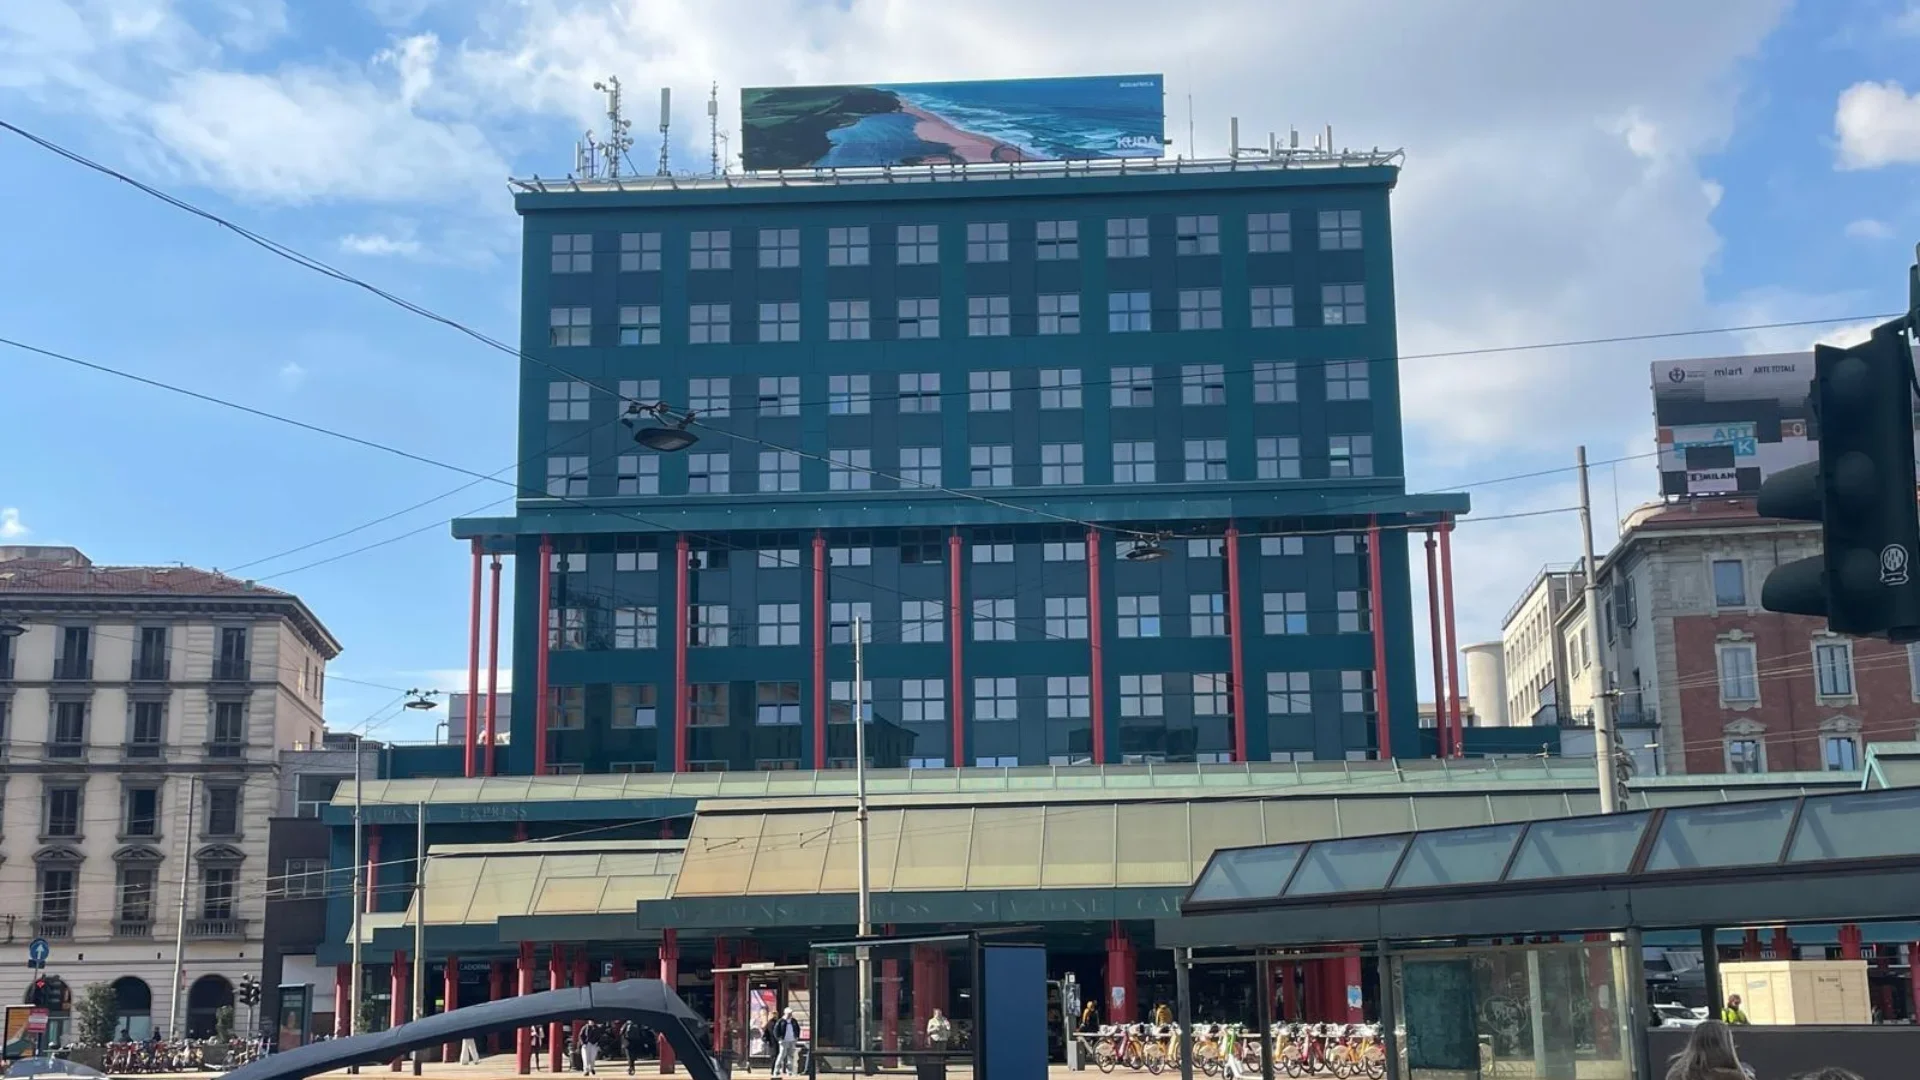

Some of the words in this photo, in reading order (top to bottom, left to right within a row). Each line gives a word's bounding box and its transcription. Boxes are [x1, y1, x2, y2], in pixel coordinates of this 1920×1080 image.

[1115, 135, 1158, 149] KUDA
[1714, 366, 1743, 376] miart
[1753, 366, 1771, 374] ARTE
[1772, 364, 1796, 373] TOTALE
[460, 806, 528, 820] EXPRESS
